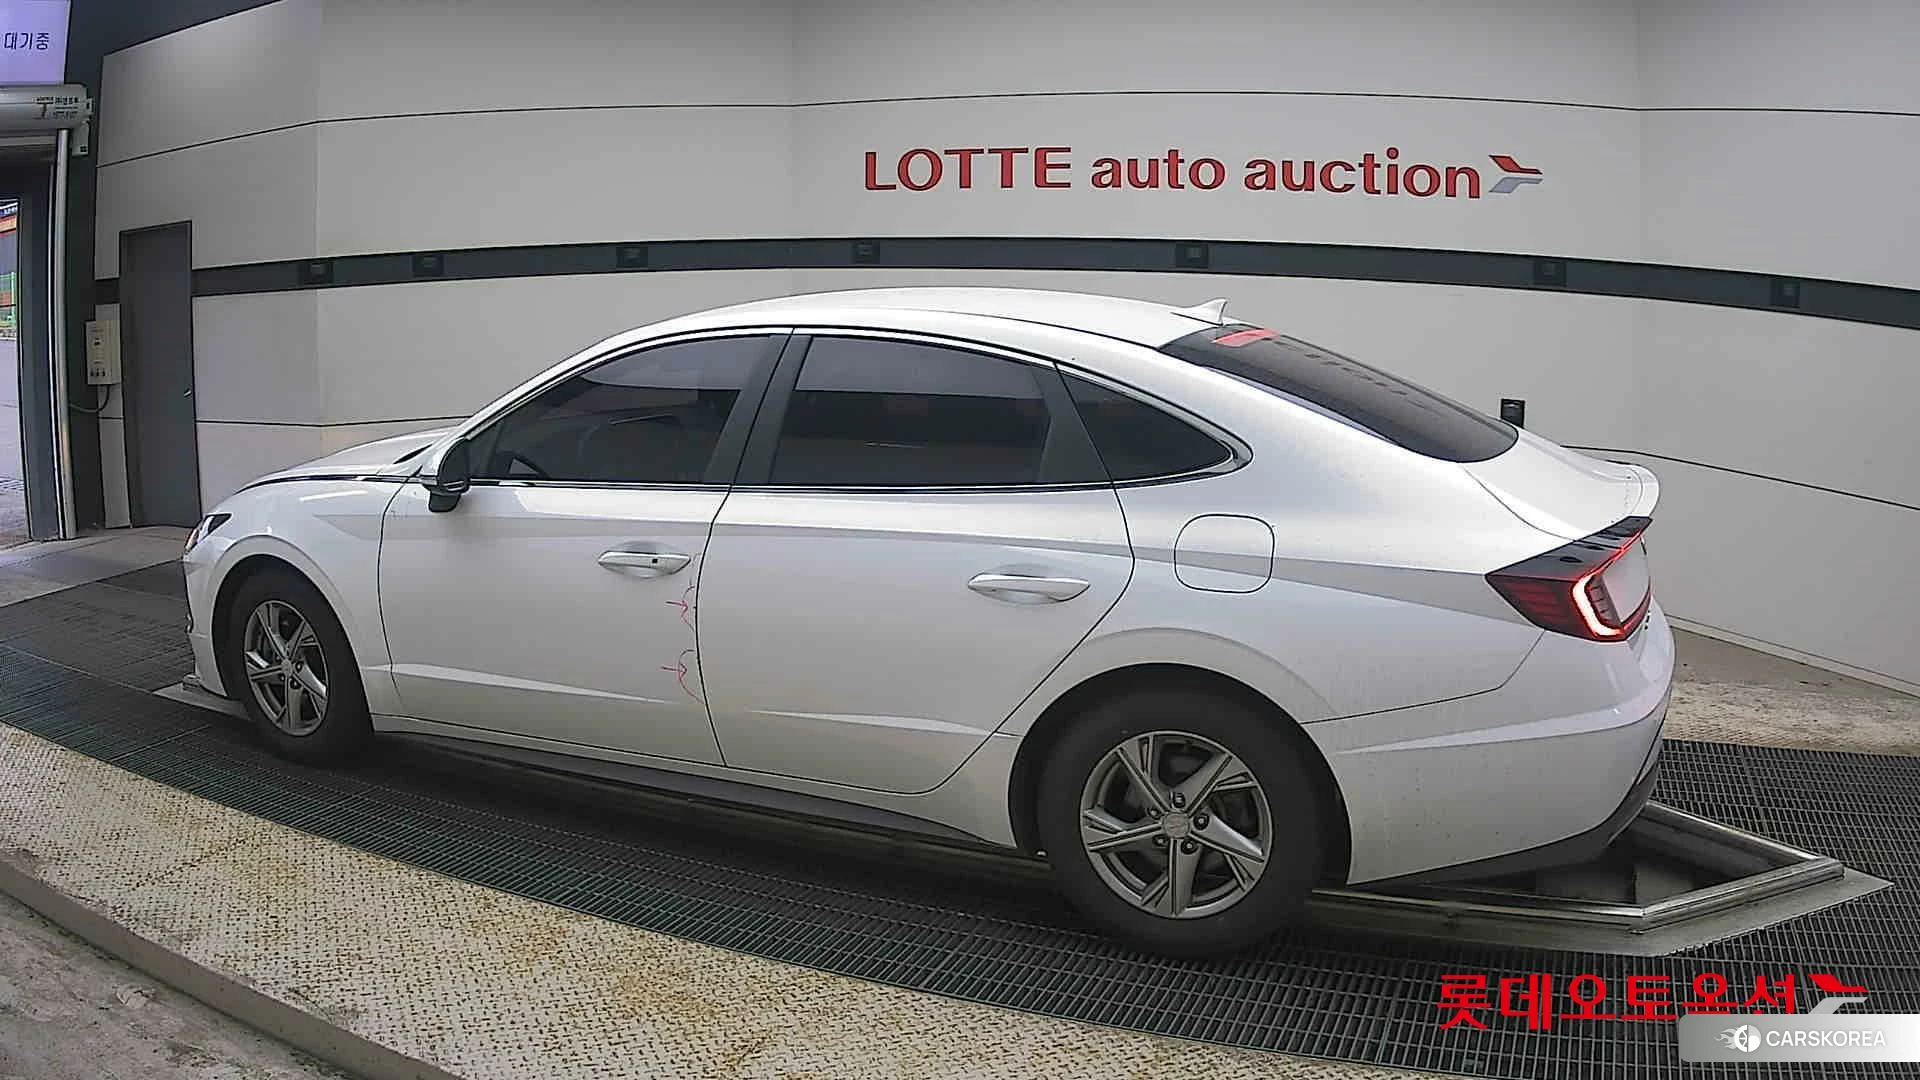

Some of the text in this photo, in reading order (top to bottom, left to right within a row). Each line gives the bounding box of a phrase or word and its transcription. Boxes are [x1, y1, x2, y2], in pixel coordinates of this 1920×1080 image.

[4, 32, 49, 50] 대기중
[864, 147, 1480, 199] LOTTE auto auction
